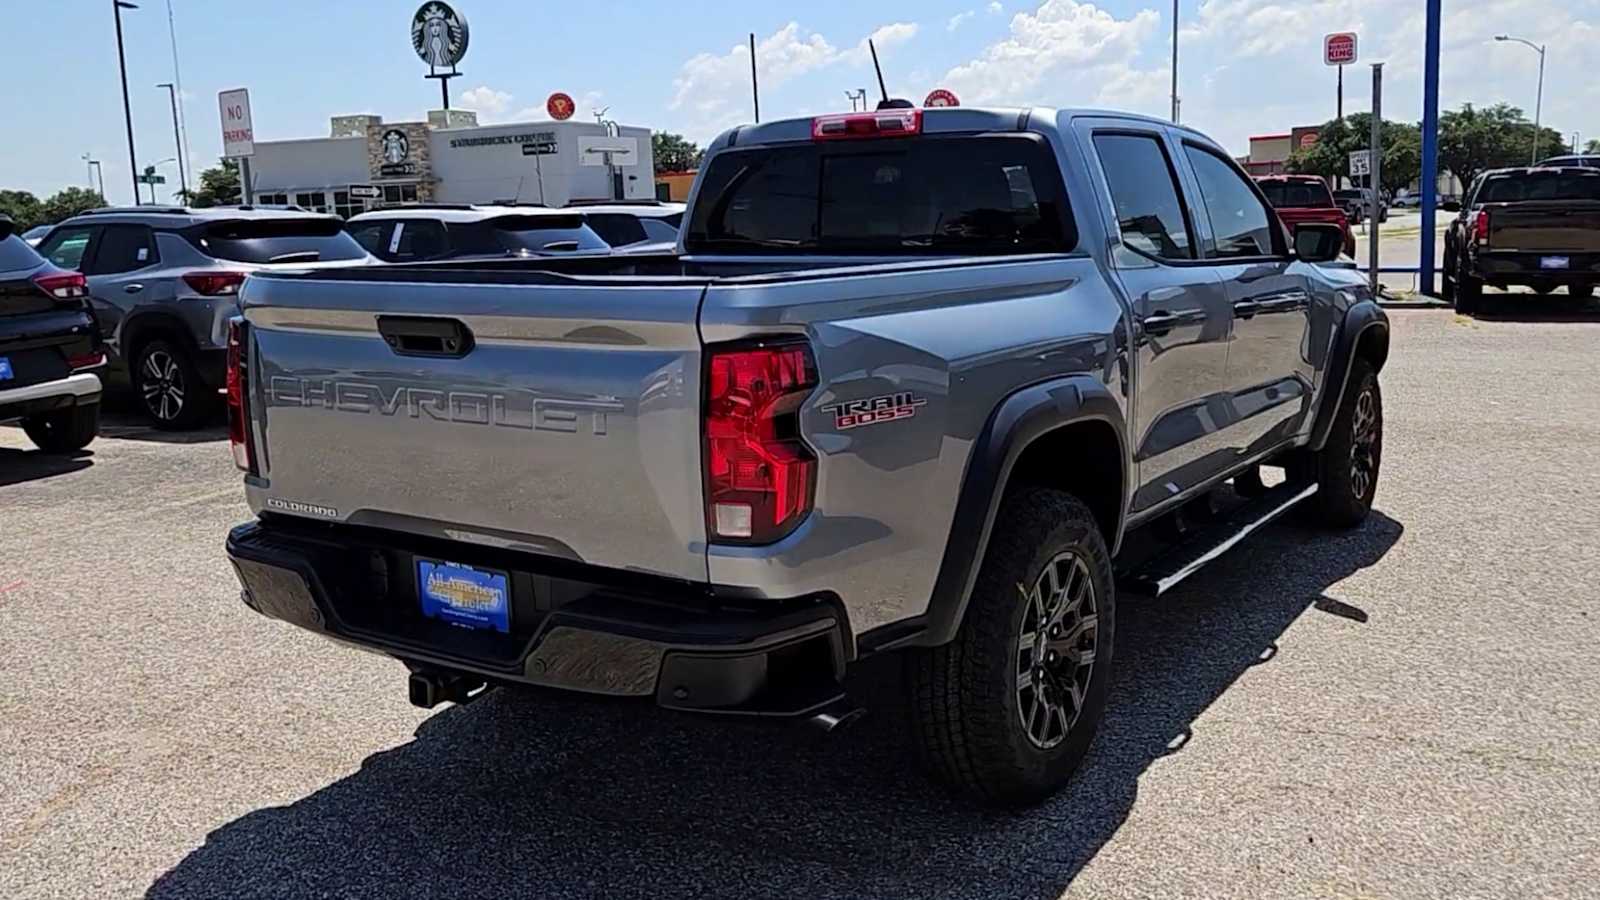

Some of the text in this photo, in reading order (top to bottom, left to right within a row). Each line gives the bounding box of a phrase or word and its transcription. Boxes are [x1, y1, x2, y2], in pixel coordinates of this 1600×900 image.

[1328, 49, 1353, 58] KING
[227, 105, 242, 120] NO
[224, 129, 252, 142] PARKING
[1353, 163, 1368, 174] 35
[271, 375, 625, 436] CHEVROLET
[821, 392, 928, 417] TRAIL
[835, 406, 915, 430] BOSS
[267, 498, 338, 518] COLORADO
